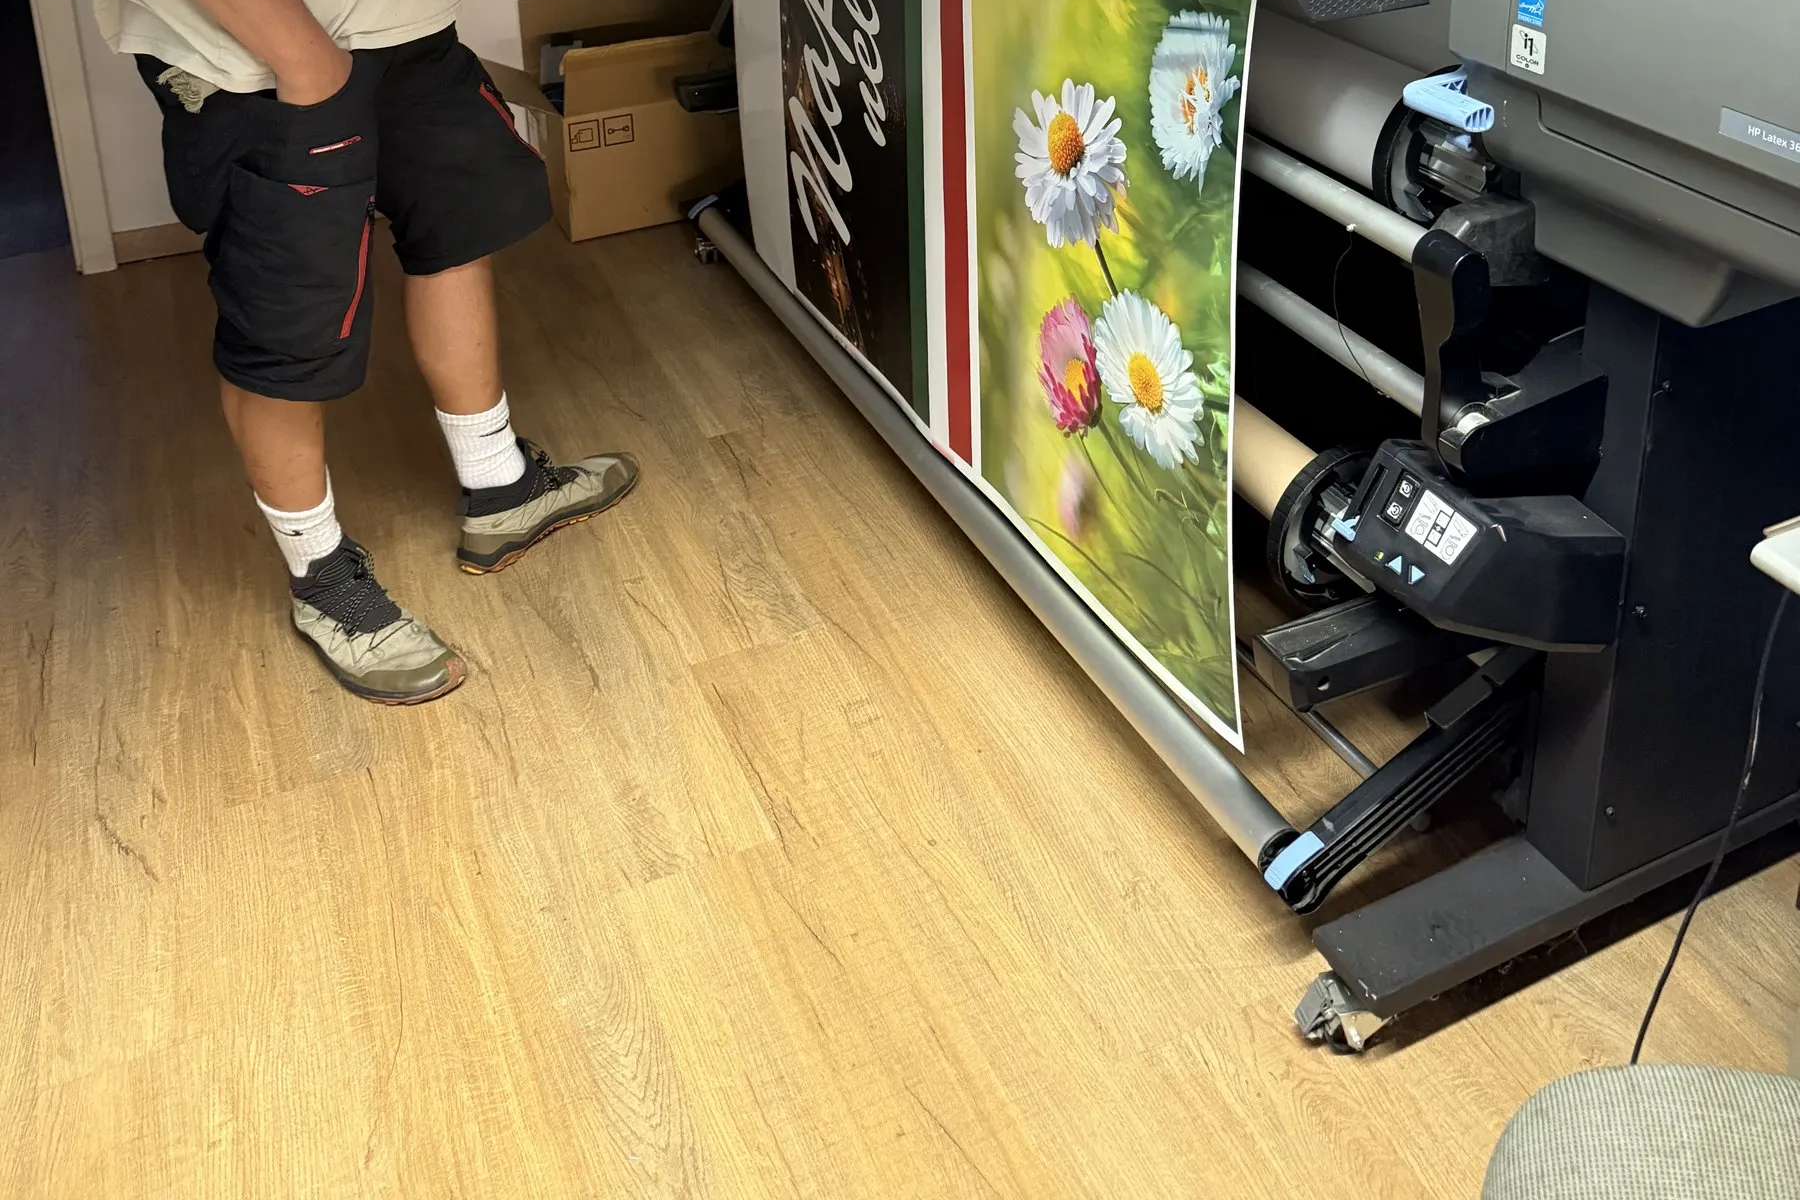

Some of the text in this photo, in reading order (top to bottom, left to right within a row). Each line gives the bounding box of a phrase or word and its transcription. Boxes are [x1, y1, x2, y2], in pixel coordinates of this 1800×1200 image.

[1516, 54, 1539, 66] COLOR
[1748, 124, 1761, 137] HP
[1762, 130, 1788, 148] Latex
